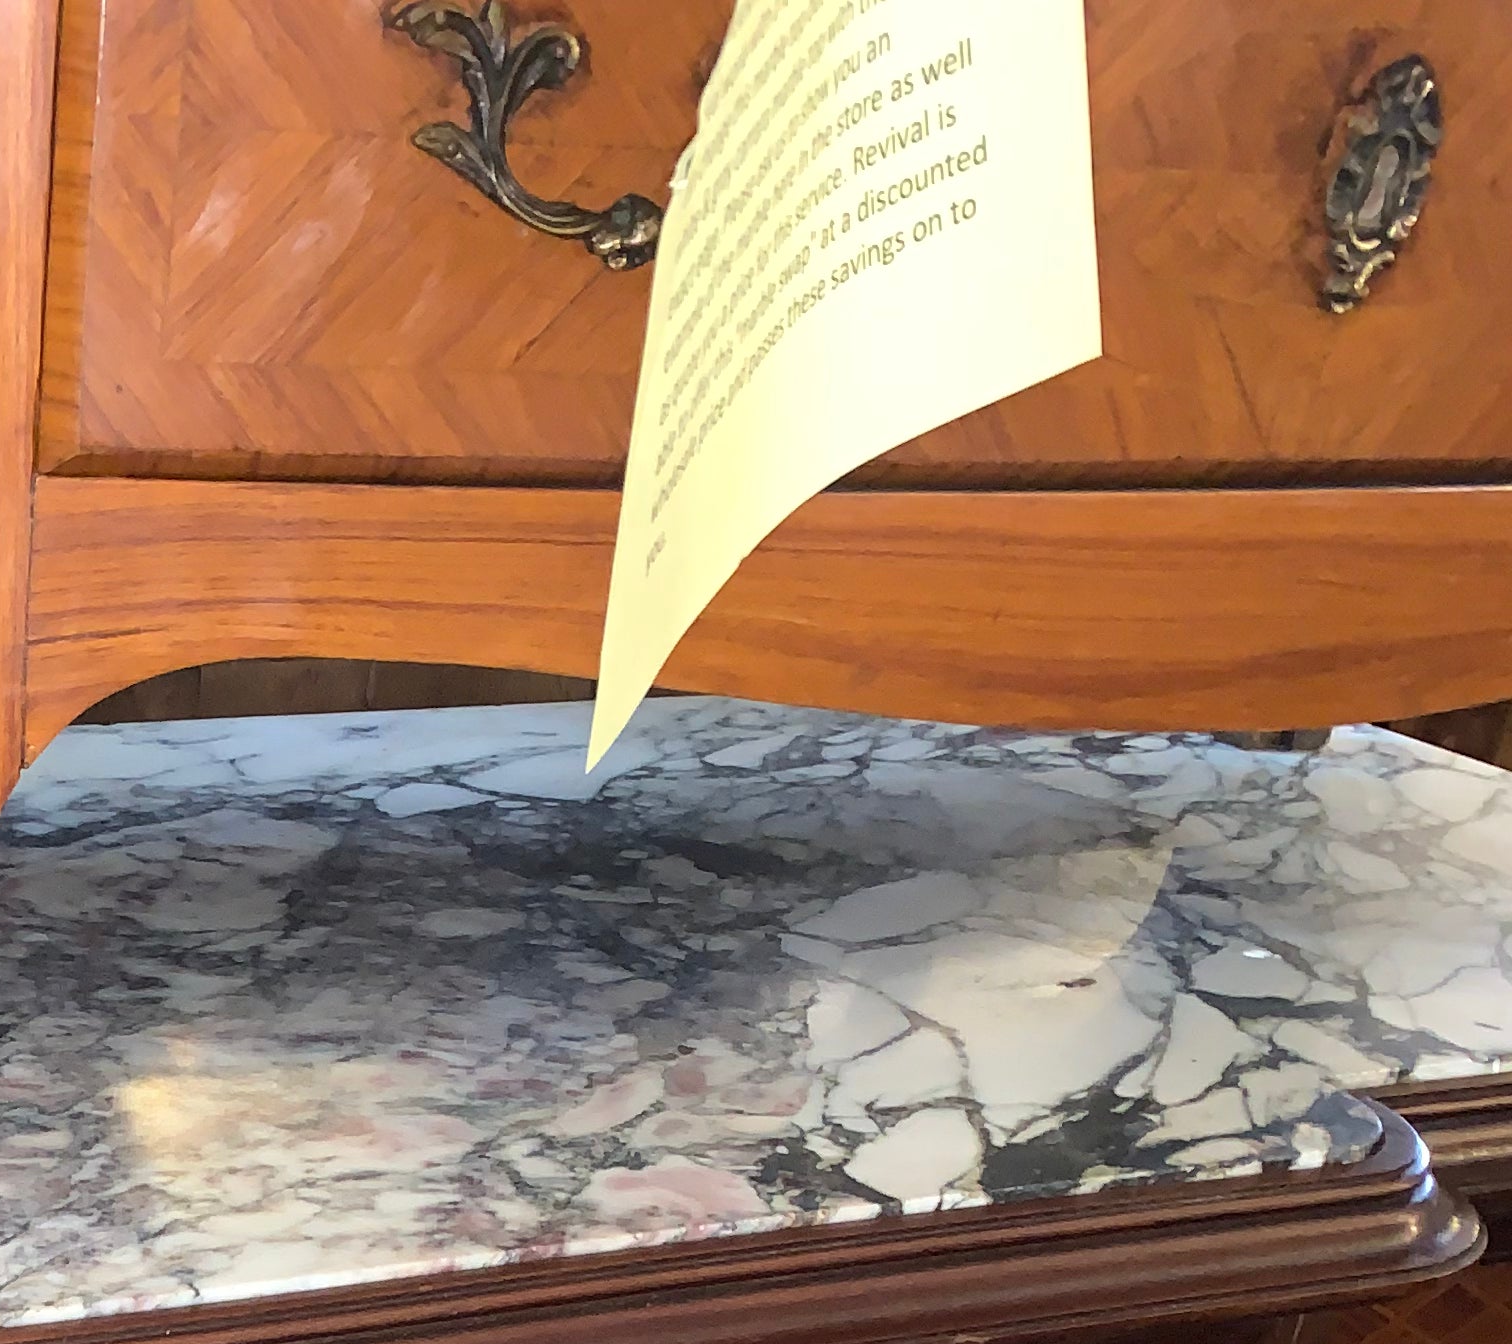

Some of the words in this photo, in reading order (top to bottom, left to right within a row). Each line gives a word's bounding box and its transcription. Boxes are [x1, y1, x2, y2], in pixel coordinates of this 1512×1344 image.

[833, 50, 861, 95] you
[866, 32, 891, 64] an
[837, 89, 883, 138] store
[890, 72, 915, 103] as
[921, 37, 973, 85] well
[794, 167, 847, 227] service.
[853, 109, 930, 176] Revival
[937, 103, 957, 131] is
[819, 218, 836, 250] at
[841, 212, 851, 234] a
[856, 134, 988, 223] discounted
[787, 276, 826, 328] these
[830, 230, 906, 291] savings
[912, 212, 944, 243] on
[949, 197, 978, 226] to
